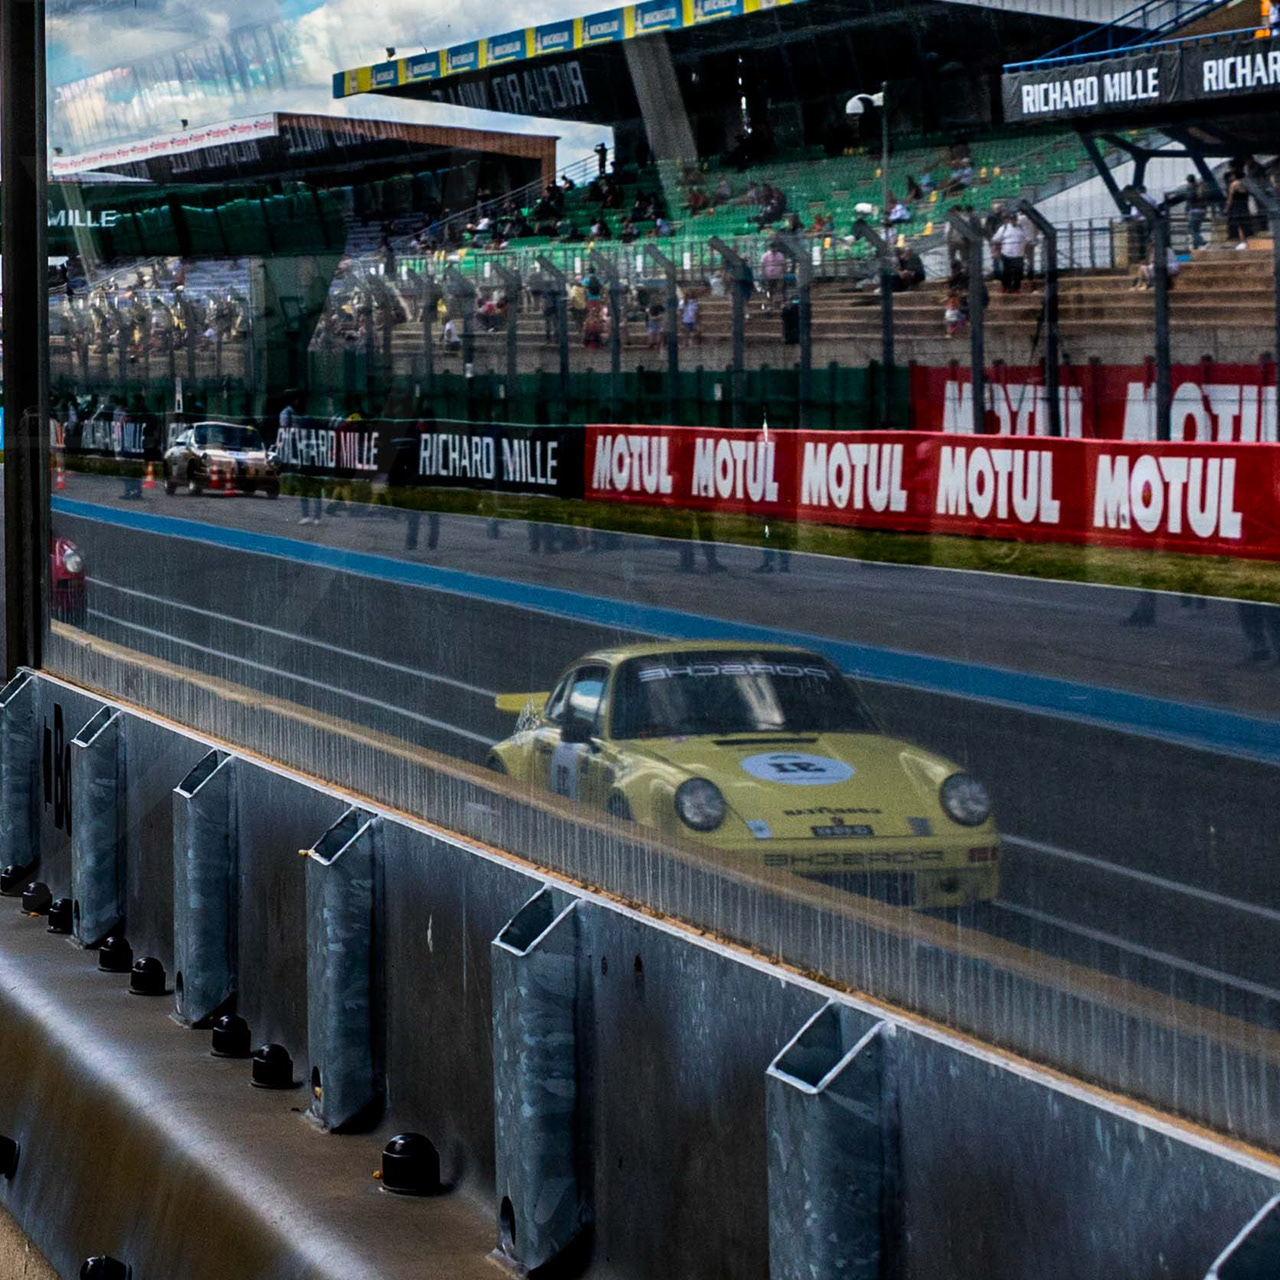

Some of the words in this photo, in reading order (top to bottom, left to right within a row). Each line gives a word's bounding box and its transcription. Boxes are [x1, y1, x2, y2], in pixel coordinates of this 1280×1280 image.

[1022, 76, 1098, 114] RICHARD
[1103, 68, 1160, 104] MILLE
[340, 431, 379, 471] MILLE
[419, 433, 494, 480] RICHARD
[501, 438, 558, 485] MILLE
[592, 433, 672, 494] MOTUL
[692, 437, 779, 502] MOTUL
[801, 441, 907, 512] MOTUL
[936, 446, 1060, 524] MOTUL
[1093, 454, 1243, 539] MOTUL
